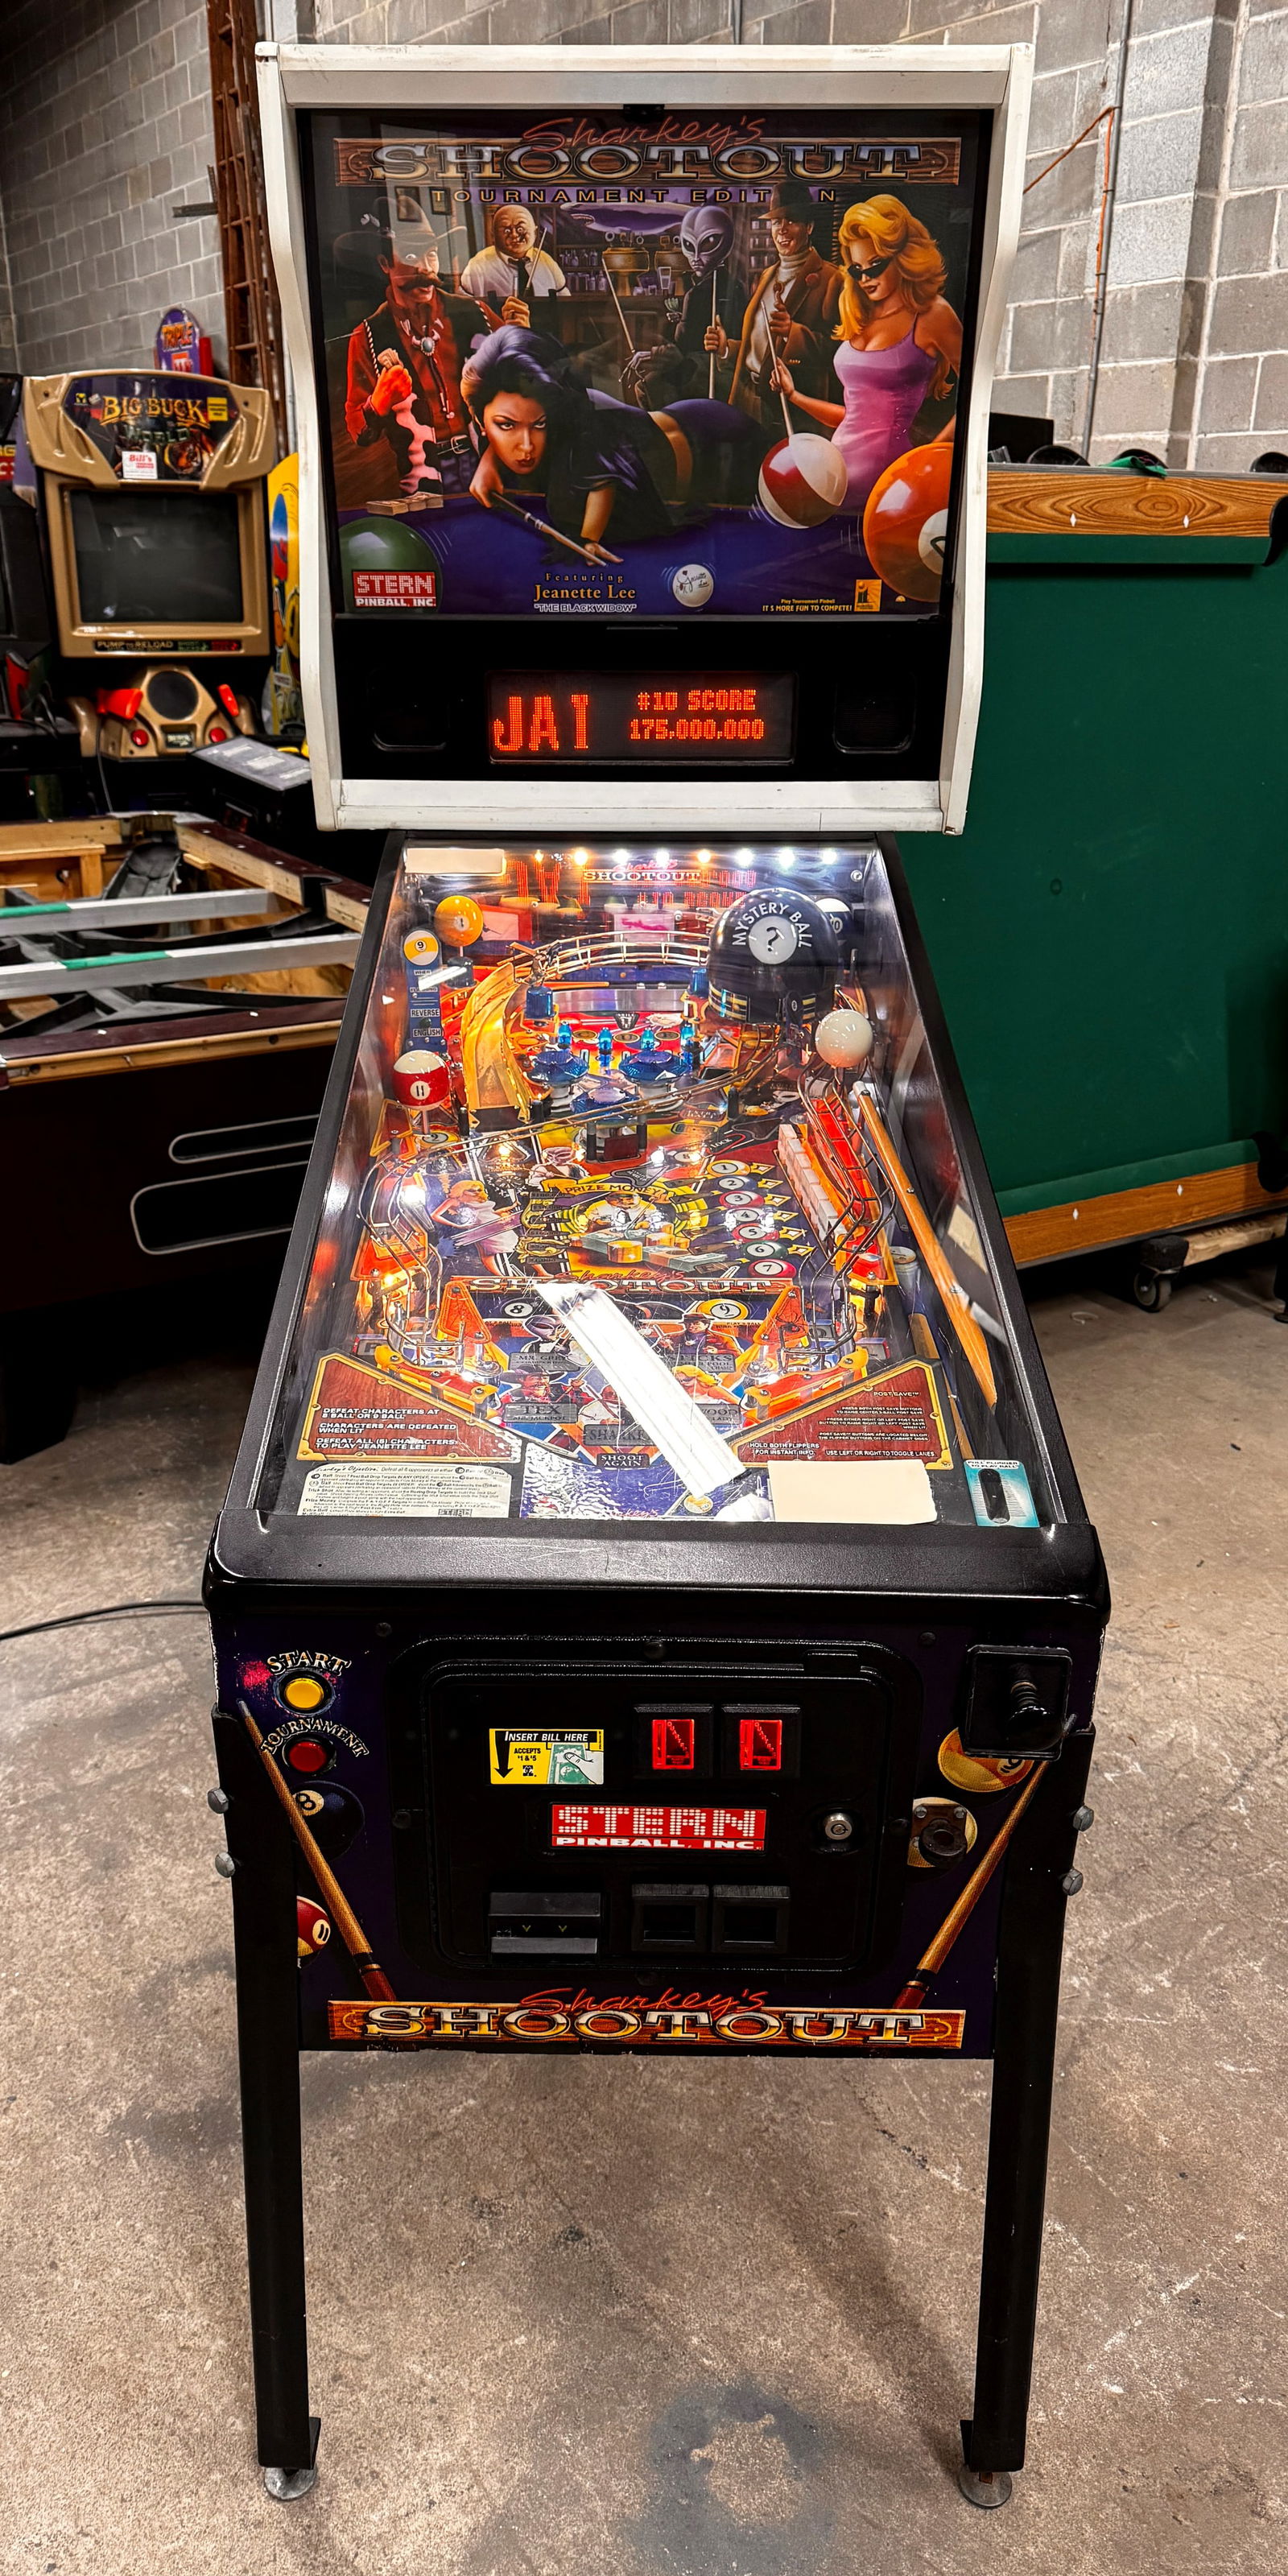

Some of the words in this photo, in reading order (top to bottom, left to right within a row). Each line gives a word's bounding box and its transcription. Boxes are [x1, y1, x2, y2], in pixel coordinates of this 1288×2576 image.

[523, 116, 766, 155] Sharkey's
[369, 143, 922, 181] SHOOTOUT
[432, 188, 667, 203] TOURNAMENT
[691, 189, 836, 203] EDITN
[101, 396, 142, 425] BIG
[147, 398, 210, 429] BUCK
[357, 575, 432, 594] STERN
[546, 573, 624, 584] Featuring
[535, 584, 601, 602] Jeanette
[607, 585, 636, 600] Lee
[356, 597, 411, 607] PINBALL,
[413, 598, 436, 607] INC.
[534, 604, 559, 613] "THE
[561, 604, 593, 613] BLACK
[637, 691, 678, 711] #10
[687, 690, 757, 711] SCORE
[584, 872, 700, 881] SHOOTOUT
[732, 902, 790, 946] MYSTERY
[789, 911, 813, 948] BALL
[418, 941, 425, 949] 9
[411, 1009, 440, 1017] REVERSE
[413, 1029, 441, 1037] ENGLISH
[416, 1085, 424, 1096] 11
[565, 1185, 604, 1194] PRIZE
[609, 1185, 661, 1195] MONEY
[554, 1269, 684, 1281] Sharkey's
[762, 1265, 772, 1273] 7
[510, 1305, 524, 1314] 8
[719, 1305, 734, 1318] 9
[522, 1406, 562, 1414] TEX
[266, 1649, 353, 1677] START
[259, 1718, 370, 1758] TOURNAMENT
[505, 1731, 539, 1741] INSERT
[542, 1733, 561, 1741] BILL
[564, 1733, 588, 1742] HERE
[296, 1794, 316, 1811] 8
[558, 1806, 756, 1837] STERN
[556, 1837, 692, 1849] PINBALL,
[703, 1839, 762, 1851] INC.
[520, 1987, 769, 2021] Sharkey's
[363, 2006, 927, 2045] SHOOTOUT
